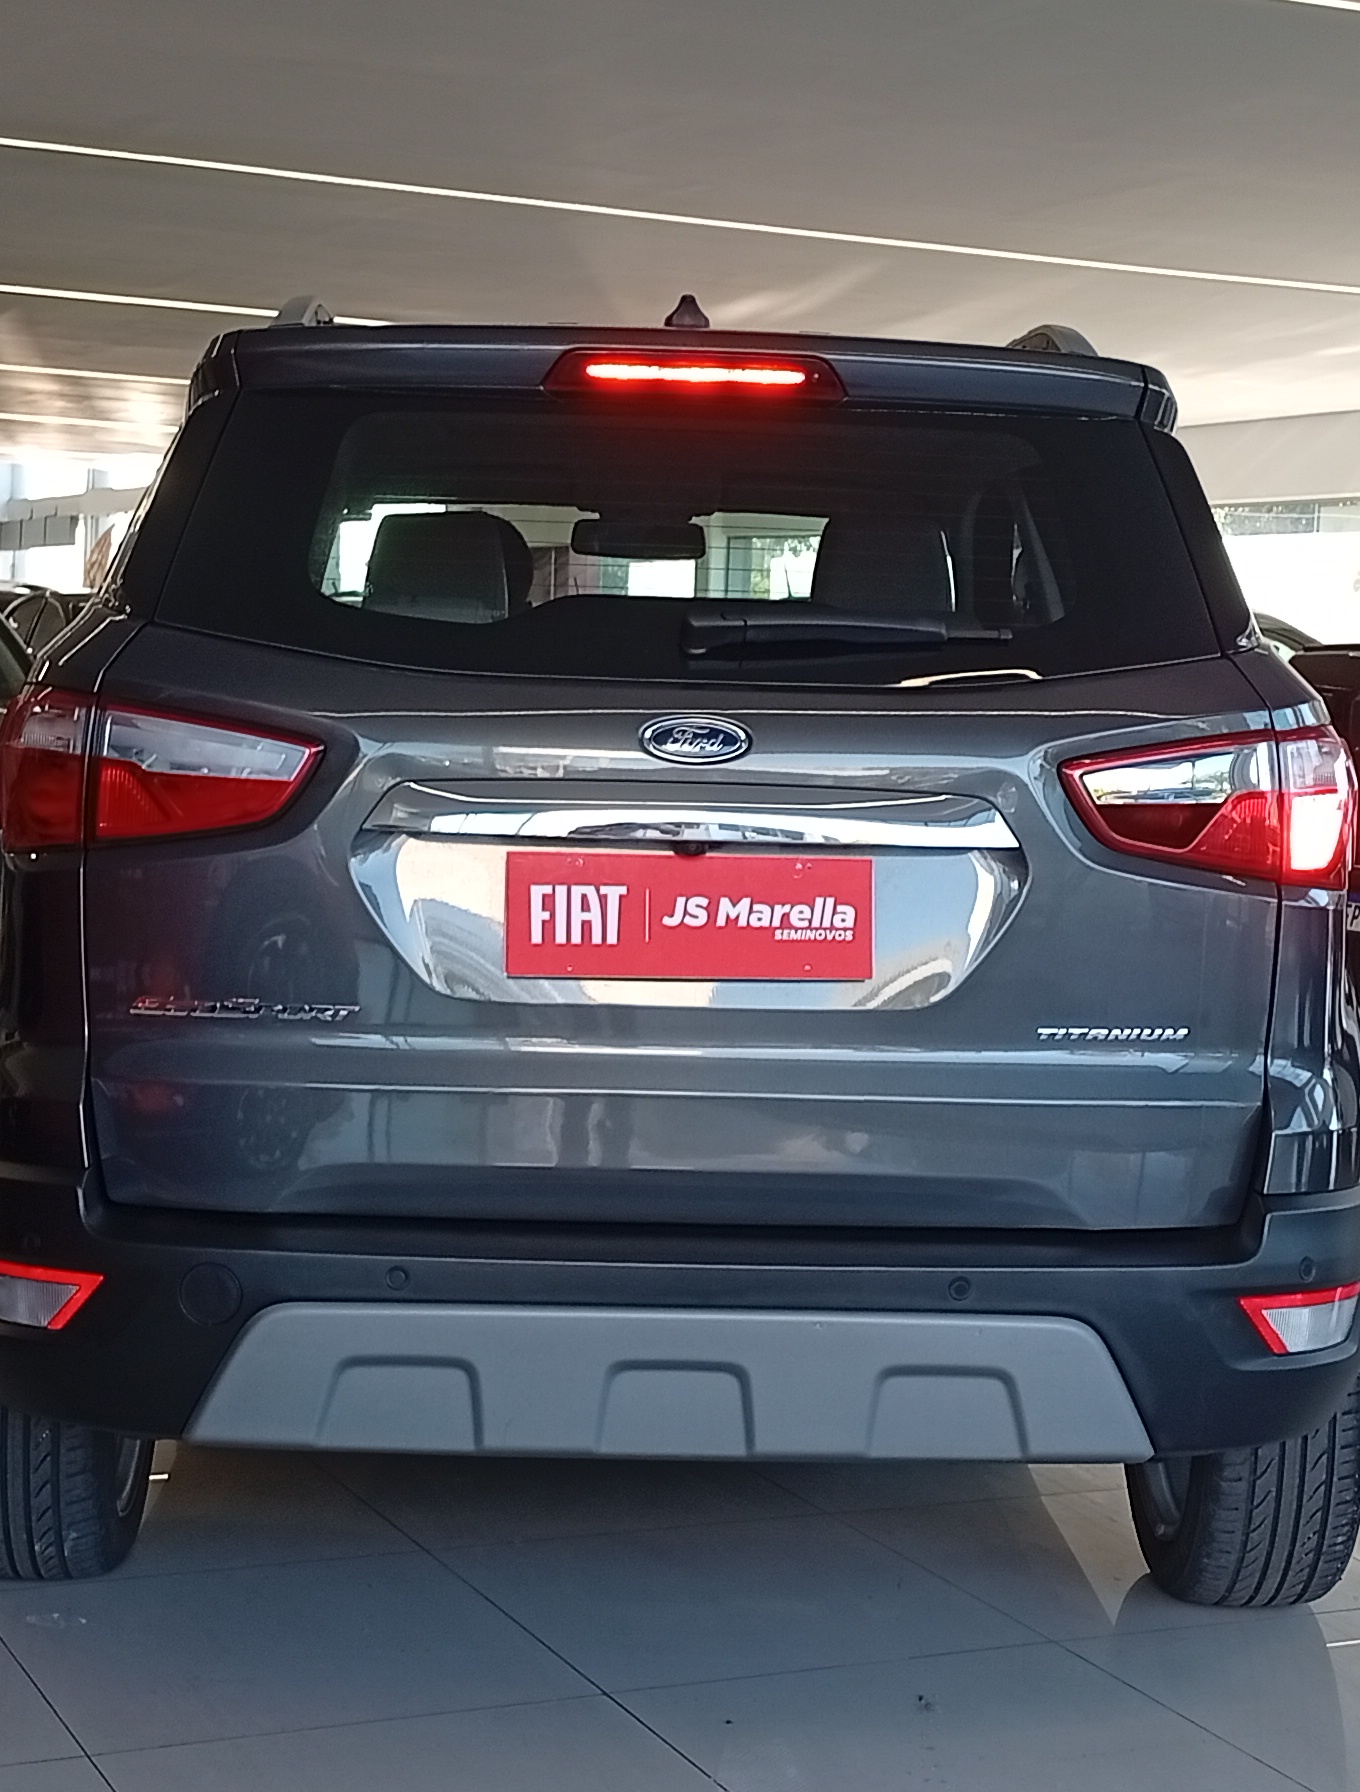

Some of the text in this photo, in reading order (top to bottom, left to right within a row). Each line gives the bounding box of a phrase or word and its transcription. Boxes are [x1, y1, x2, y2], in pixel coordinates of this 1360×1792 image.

[661, 726, 724, 753] Ford
[529, 884, 856, 946] FIAT JS Marella
[773, 928, 854, 942] SEMINOVOS
[1037, 1027, 1190, 1041] TITANIUM
